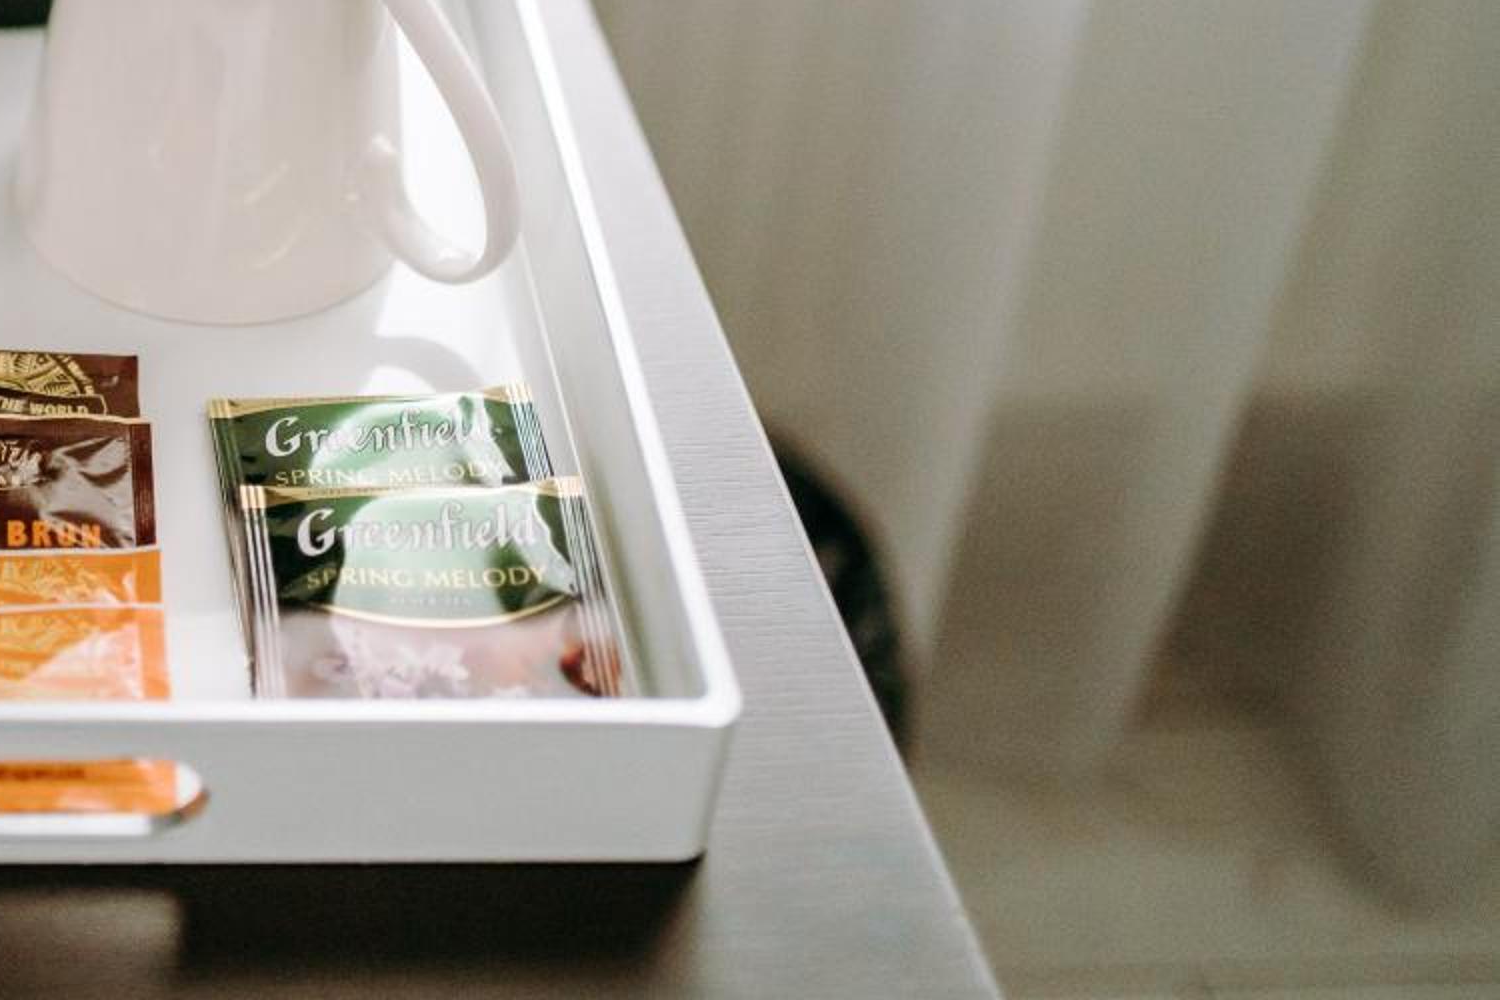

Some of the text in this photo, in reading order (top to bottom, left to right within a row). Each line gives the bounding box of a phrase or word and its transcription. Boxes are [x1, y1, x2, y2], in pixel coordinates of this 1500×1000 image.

[29, 402, 88, 416] WORLD
[265, 402, 487, 457] Grenfiel
[388, 459, 501, 485] MELOD
[297, 501, 536, 557] Greenfield
[307, 567, 546, 589] SPRING MELODY
